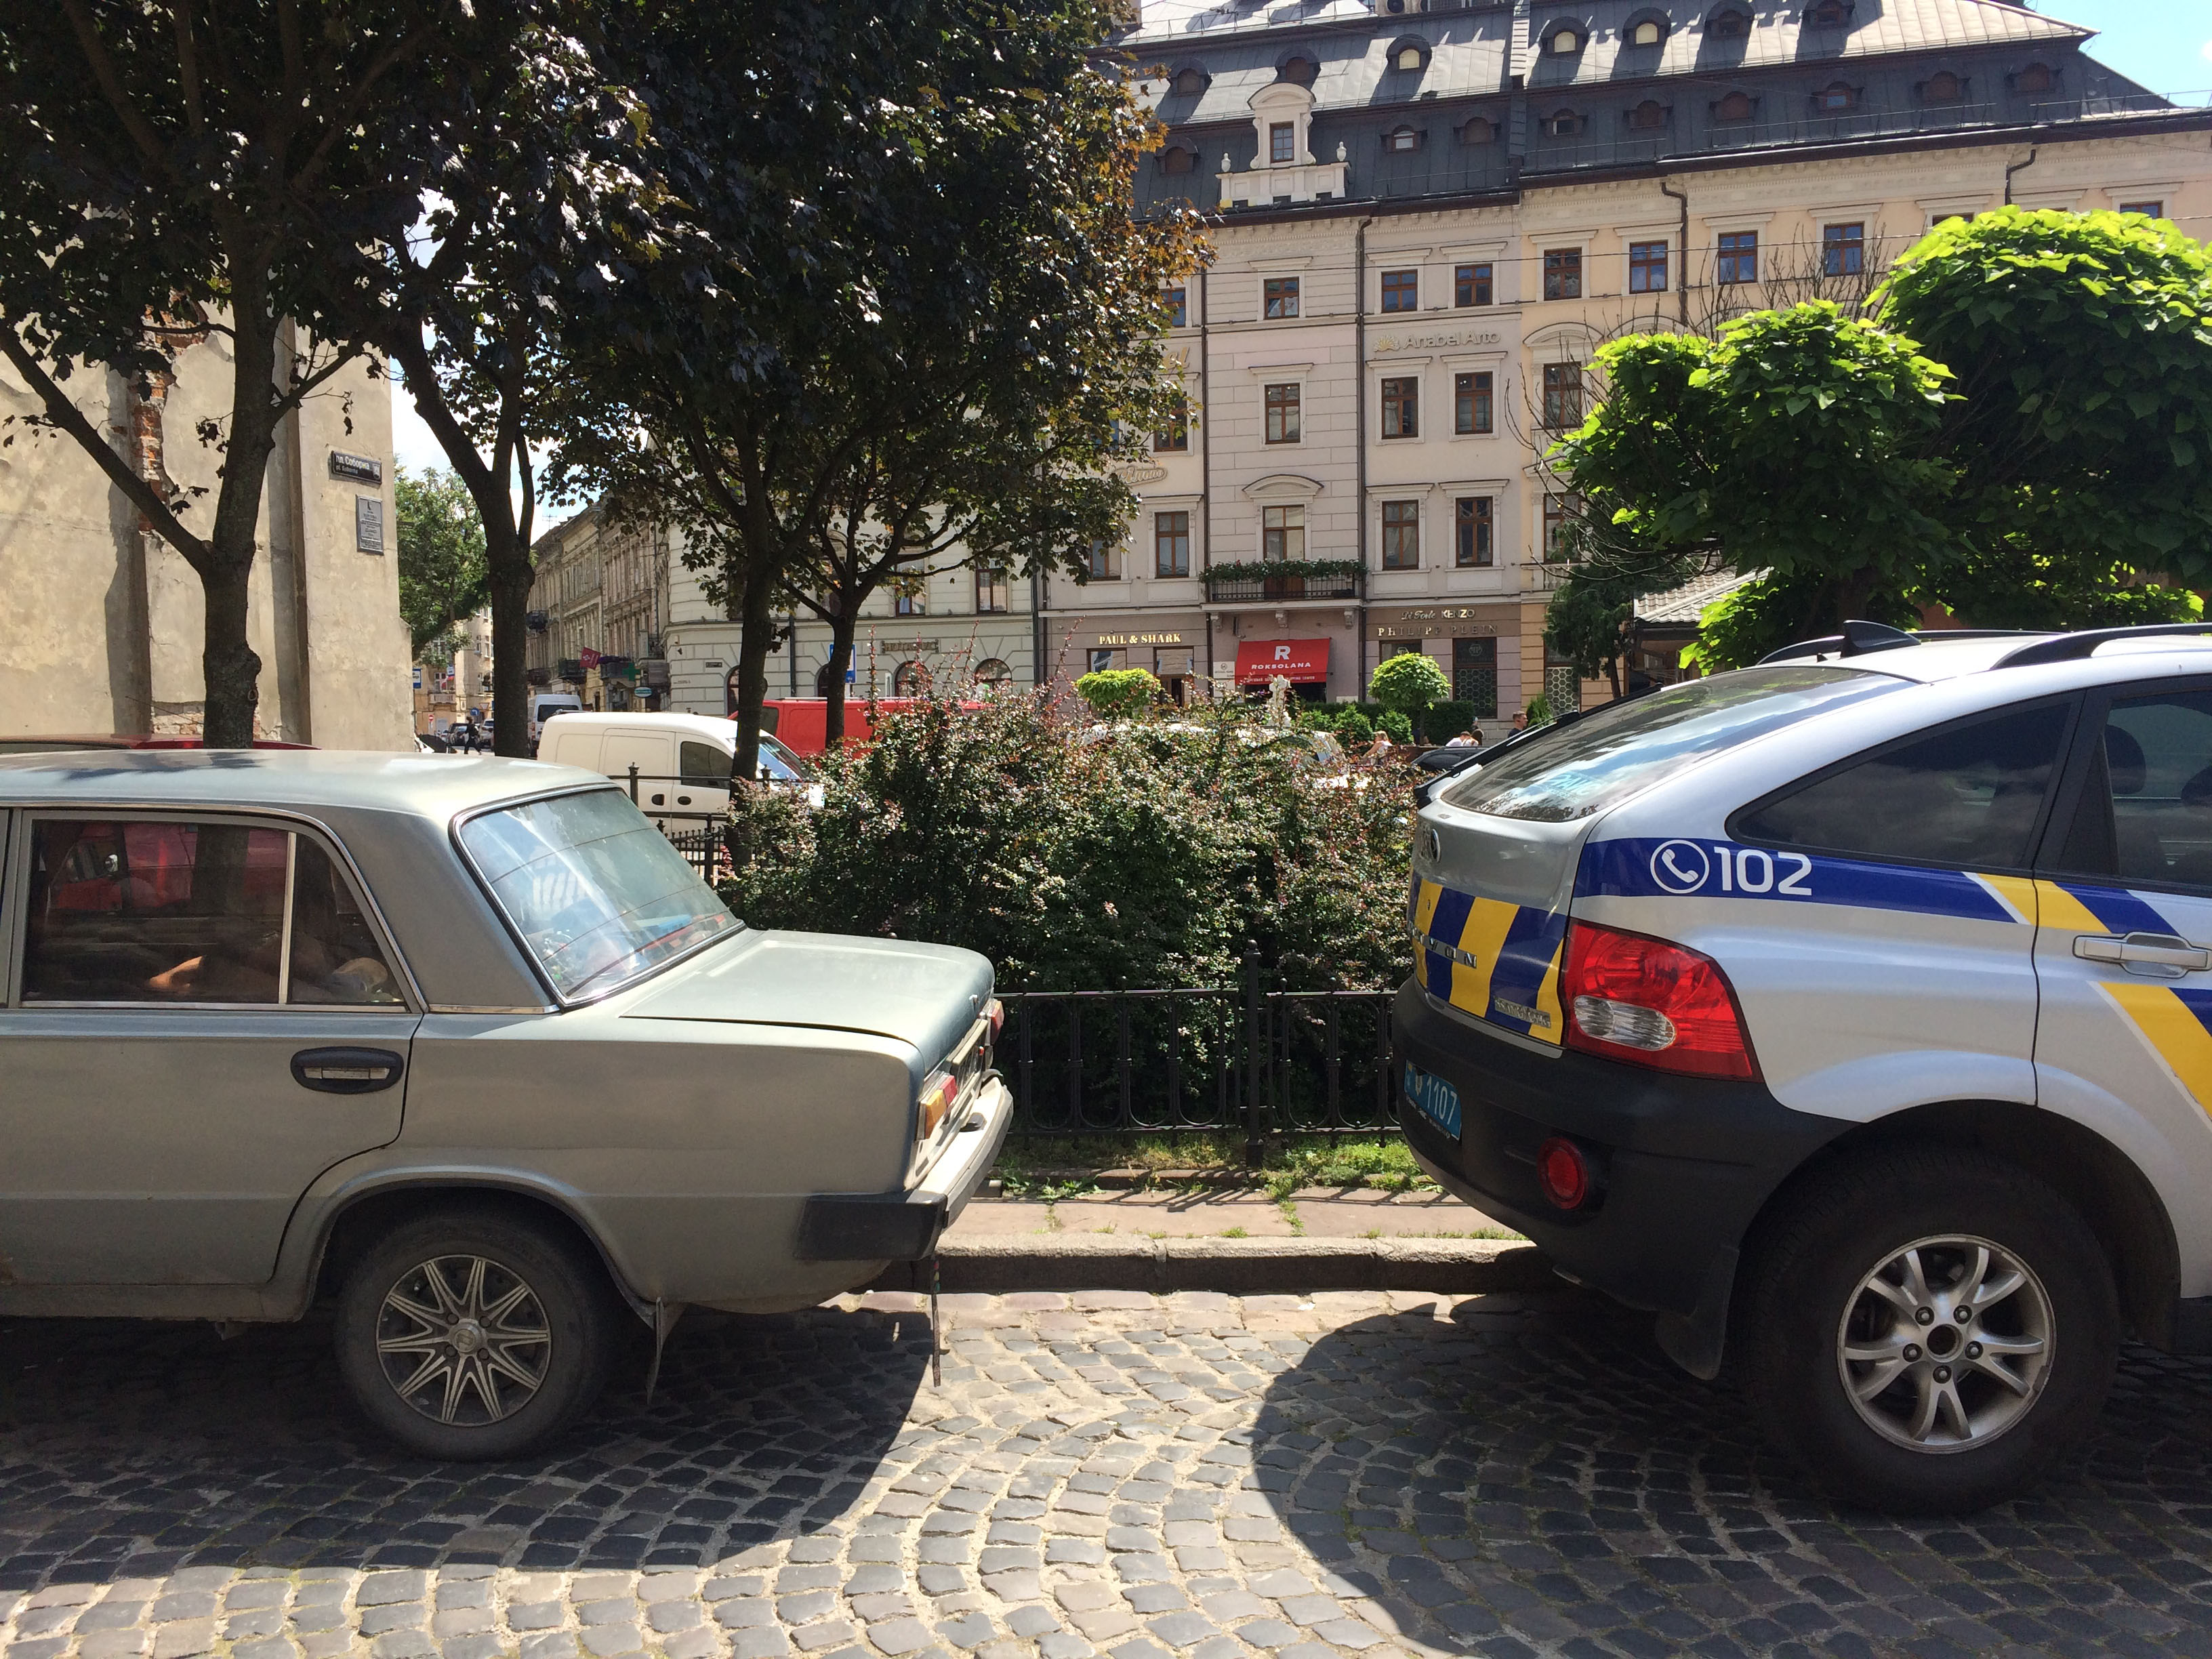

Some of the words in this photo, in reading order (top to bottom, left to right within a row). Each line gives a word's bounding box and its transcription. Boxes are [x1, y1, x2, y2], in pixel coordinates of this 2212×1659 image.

[1403, 332, 1460, 350] Anabel
[1463, 331, 1500, 345] Arto
[345, 456, 370, 470] Соборна
[1441, 609, 1475, 619] KENZO
[1378, 627, 1442, 636] PHILIPP
[1450, 624, 1498, 635] PLEIN
[1099, 636, 1126, 644] PAUL
[1129, 635, 1138, 644] &
[1141, 634, 1181, 644] SHARK
[1274, 645, 1291, 661] R
[1713, 846, 1812, 896] 102
[1427, 1076, 1457, 1125] 1107
